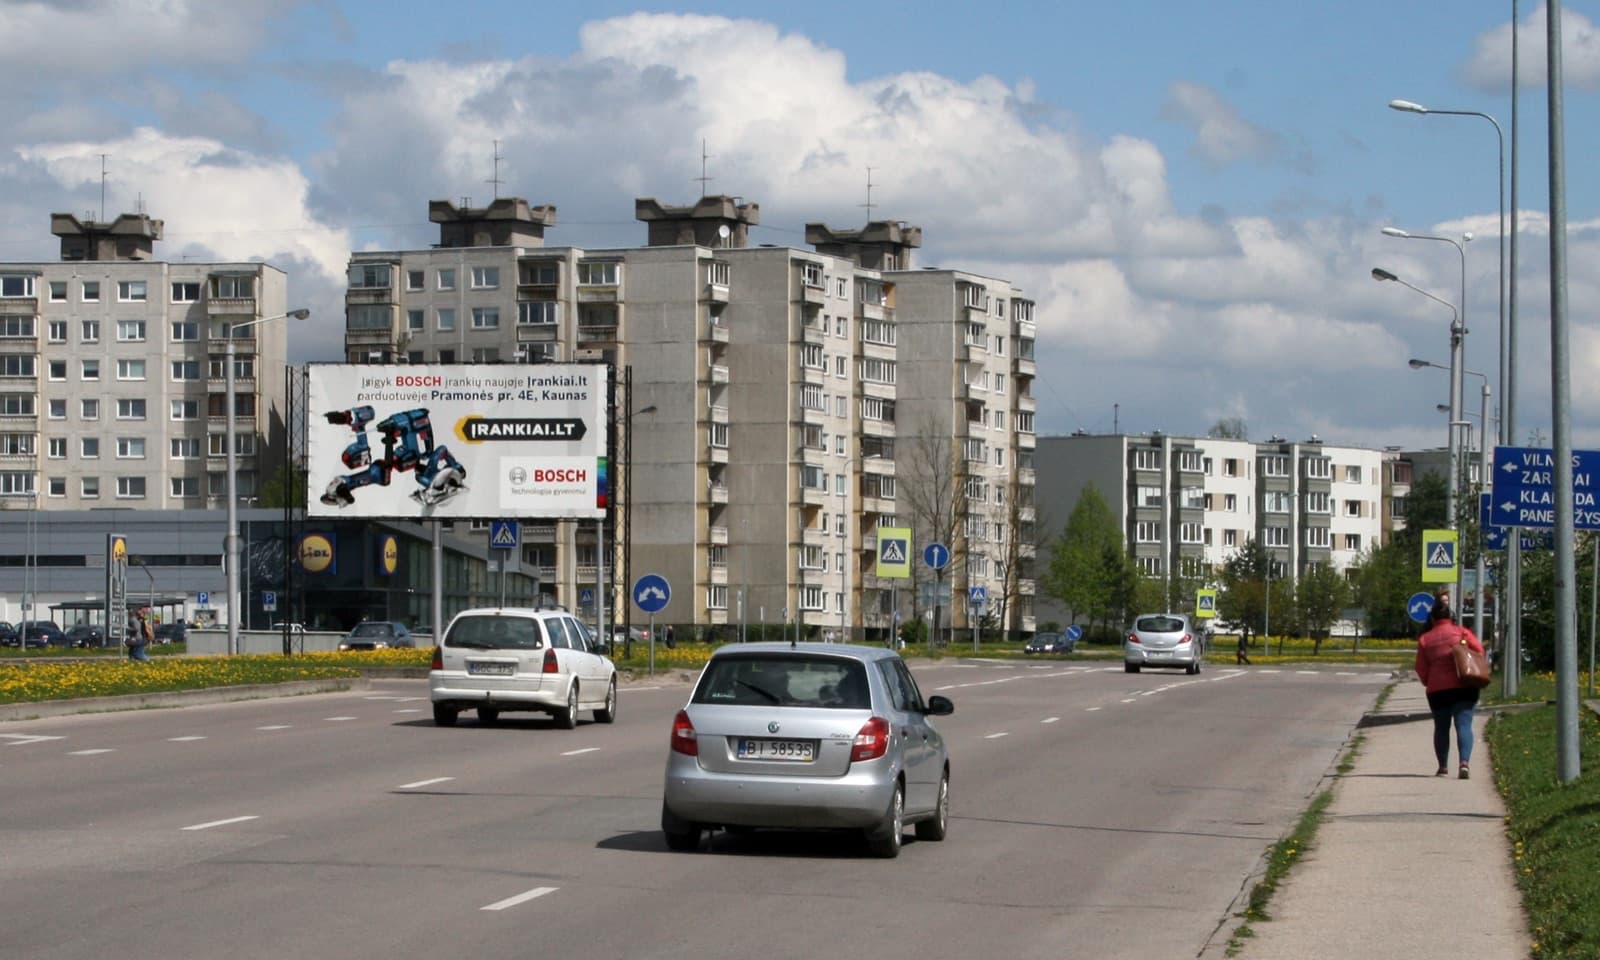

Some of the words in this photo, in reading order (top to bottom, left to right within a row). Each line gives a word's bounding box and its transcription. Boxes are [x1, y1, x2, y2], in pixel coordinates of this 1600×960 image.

[396, 376, 441, 387] BOSCH
[485, 377, 524, 389] naujoje
[527, 376, 588, 388] Įrankiai.lt
[357, 391, 428, 403] parduotuvėje
[431, 390, 494, 401] Pramonės
[498, 392, 514, 403] pr.
[518, 390, 538, 402] 4E,
[542, 390, 587, 401] Kaunas
[471, 423, 575, 439] ĮRANKIAI.LT
[1523, 453, 1581, 468] VILNS
[534, 469, 587, 482] BOSCH
[1521, 471, 1590, 486] ZARAI
[1520, 490, 1595, 506] KLAIDA
[1520, 508, 1600, 525] PANEŽYS
